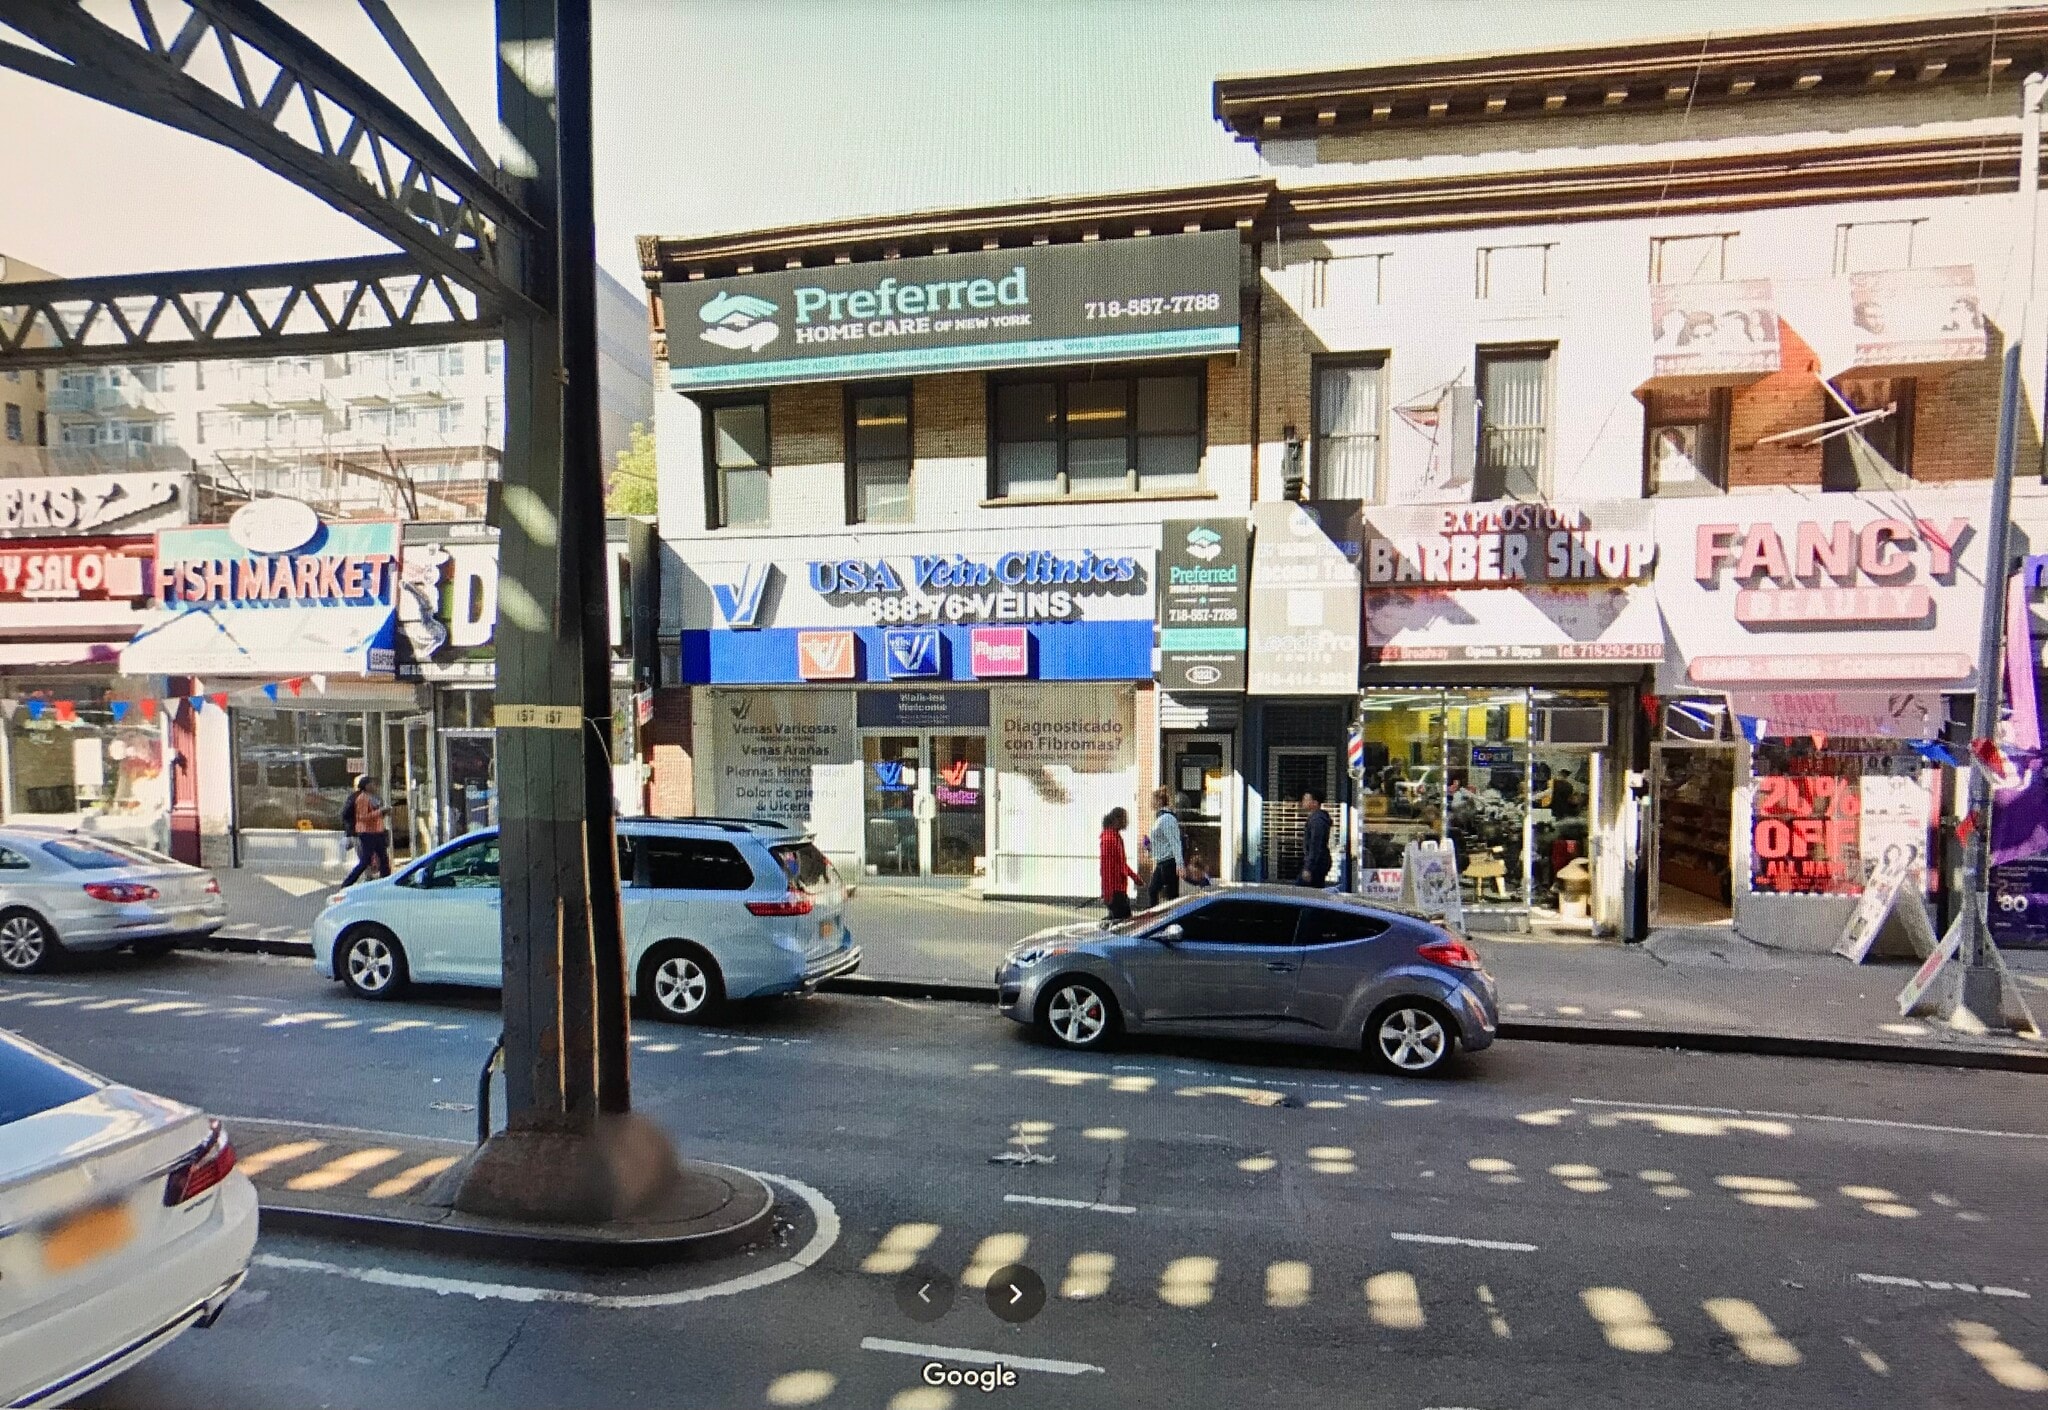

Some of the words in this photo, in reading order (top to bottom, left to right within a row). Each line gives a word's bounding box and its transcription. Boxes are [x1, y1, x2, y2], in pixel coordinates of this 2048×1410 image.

[793, 266, 1029, 323] Preferred
[796, 322, 864, 343] HOME
[868, 317, 930, 338] CARE
[934, 319, 953, 332] OF
[955, 317, 990, 331] NEW
[990, 314, 1032, 328] YORK
[1442, 503, 1582, 533] EXPLOSION
[1368, 532, 1528, 582] BARBER
[1548, 531, 1655, 580] SHOP
[1695, 517, 1970, 580] FANCY
[25, 553, 126, 592] SALO
[156, 559, 231, 602] FISH
[237, 554, 389, 600] MARKET
[805, 558, 901, 594] USA
[912, 552, 991, 590] Vein
[995, 547, 1136, 586] Clinics
[1169, 564, 1238, 584] Preferred
[865, 589, 1073, 622] 888-76-VEINS
[1751, 588, 1913, 617] BEAUTY
[1465, 645, 1498, 658] Open
[1500, 646, 1508, 657] 7
[1511, 644, 1542, 659] Days
[516, 710, 534, 722] 157
[544, 711, 562, 724] 157
[898, 702, 948, 712] Welcome
[732, 723, 773, 735] Venas
[775, 722, 838, 735] Varicosas
[1004, 718, 1123, 736] Diagnosticado
[742, 744, 781, 756] Venas
[1004, 738, 1034, 751] con
[1037, 737, 1123, 751] Fibromas?
[725, 765, 774, 777] Piernas
[735, 786, 772, 798] Dolor
[776, 787, 792, 798] de
[756, 801, 766, 812] &
[1754, 819, 1857, 858] OFF
[1766, 860, 1797, 876] ALL
